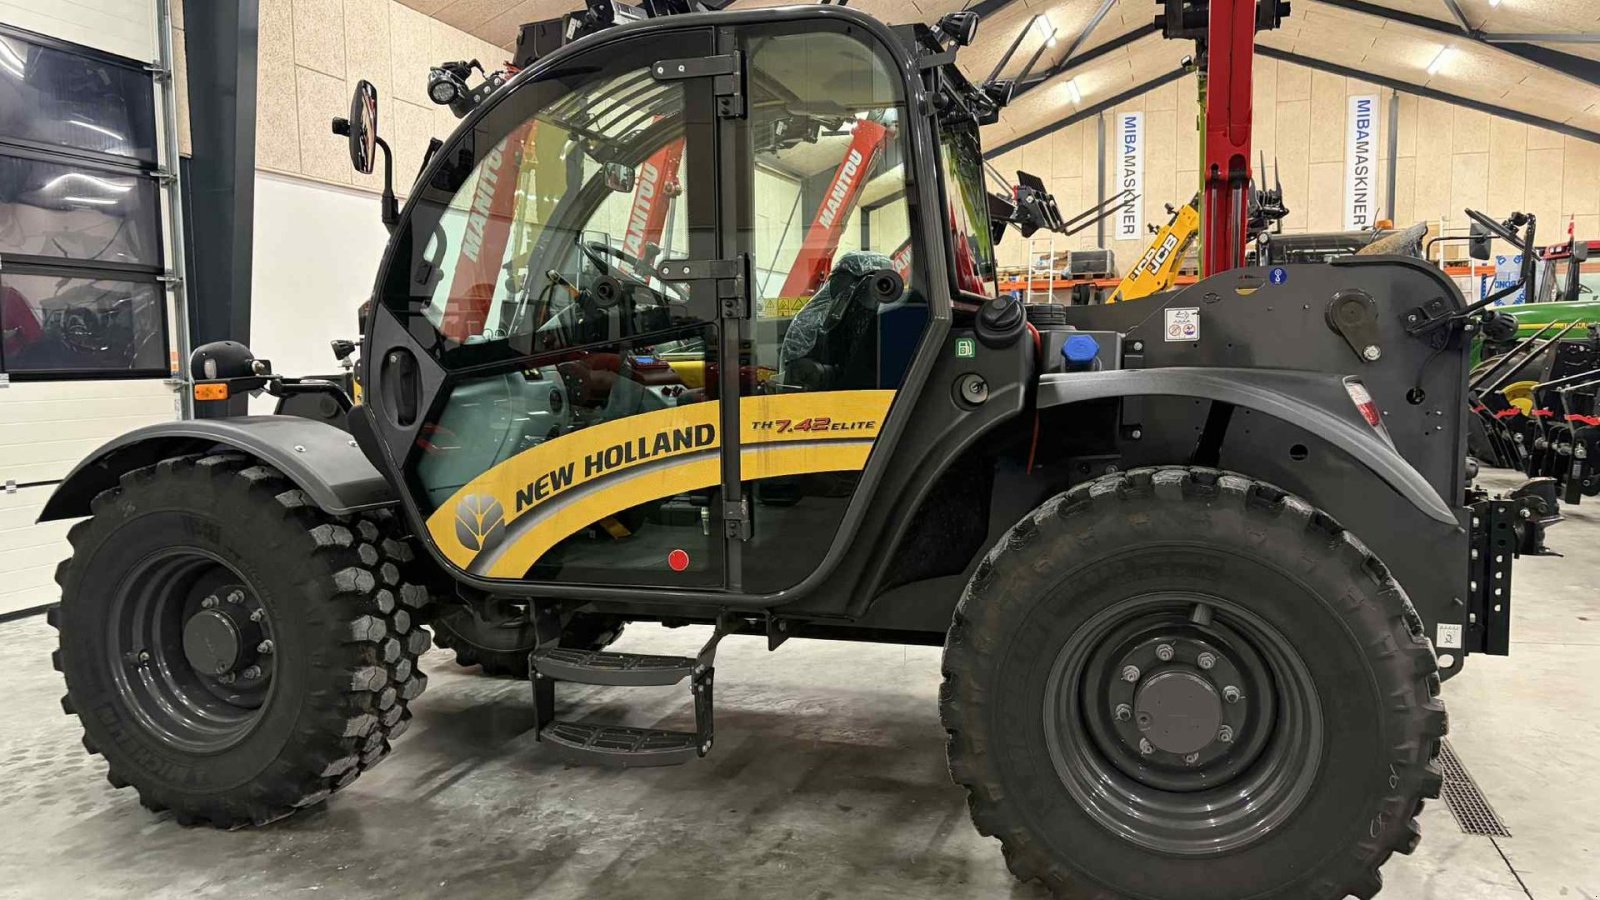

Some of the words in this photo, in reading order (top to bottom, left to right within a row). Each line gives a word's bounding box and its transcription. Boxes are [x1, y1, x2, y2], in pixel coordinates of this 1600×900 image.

[463, 136, 508, 262] MANITO
[819, 148, 863, 230] MANITOU
[1353, 99, 1370, 226] MIBAMASKINER
[1129, 247, 1156, 281] JCB
[1146, 233, 1179, 276] JCB
[516, 462, 574, 513] NEW
[584, 423, 716, 478] HOLLAND
